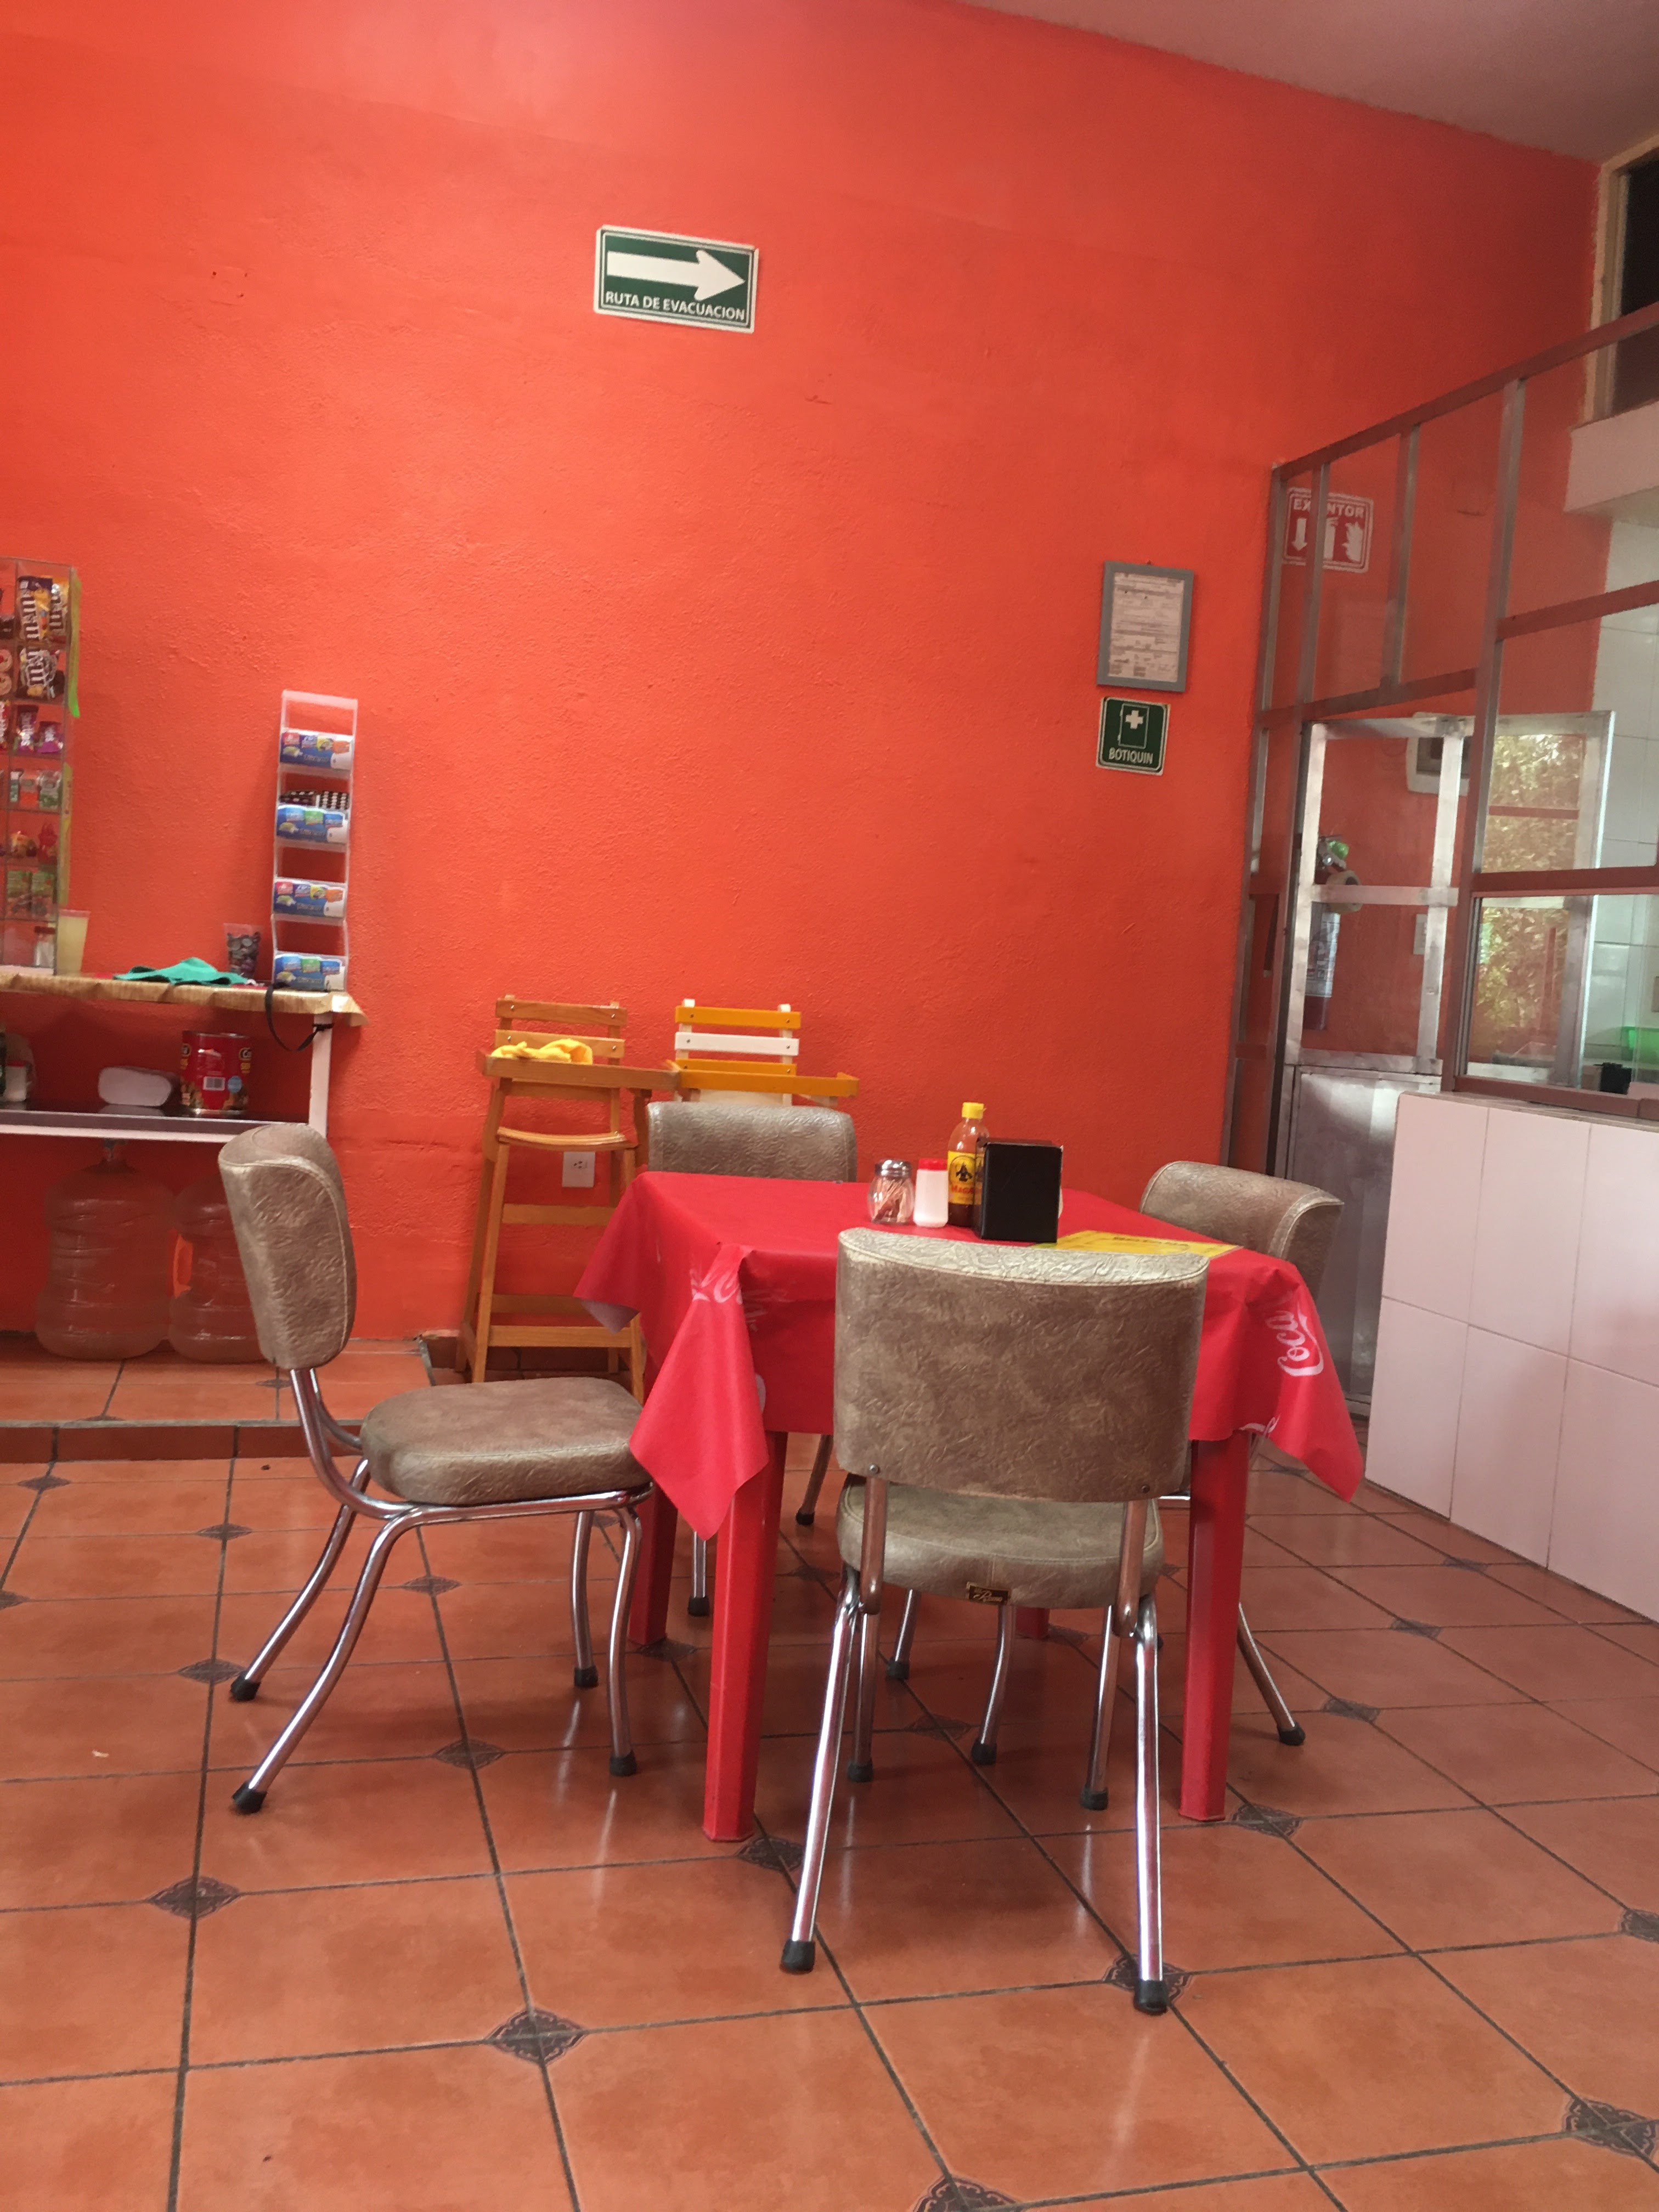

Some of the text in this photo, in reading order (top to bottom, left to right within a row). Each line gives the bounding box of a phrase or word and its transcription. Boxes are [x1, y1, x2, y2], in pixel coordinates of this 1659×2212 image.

[606, 291, 745, 321] RUTA DE EVACUACION
[1293, 498, 1365, 518] EXNTOR
[1108, 747, 1153, 765] BOTIQUIN
[1265, 1301, 1324, 1376] Coca
